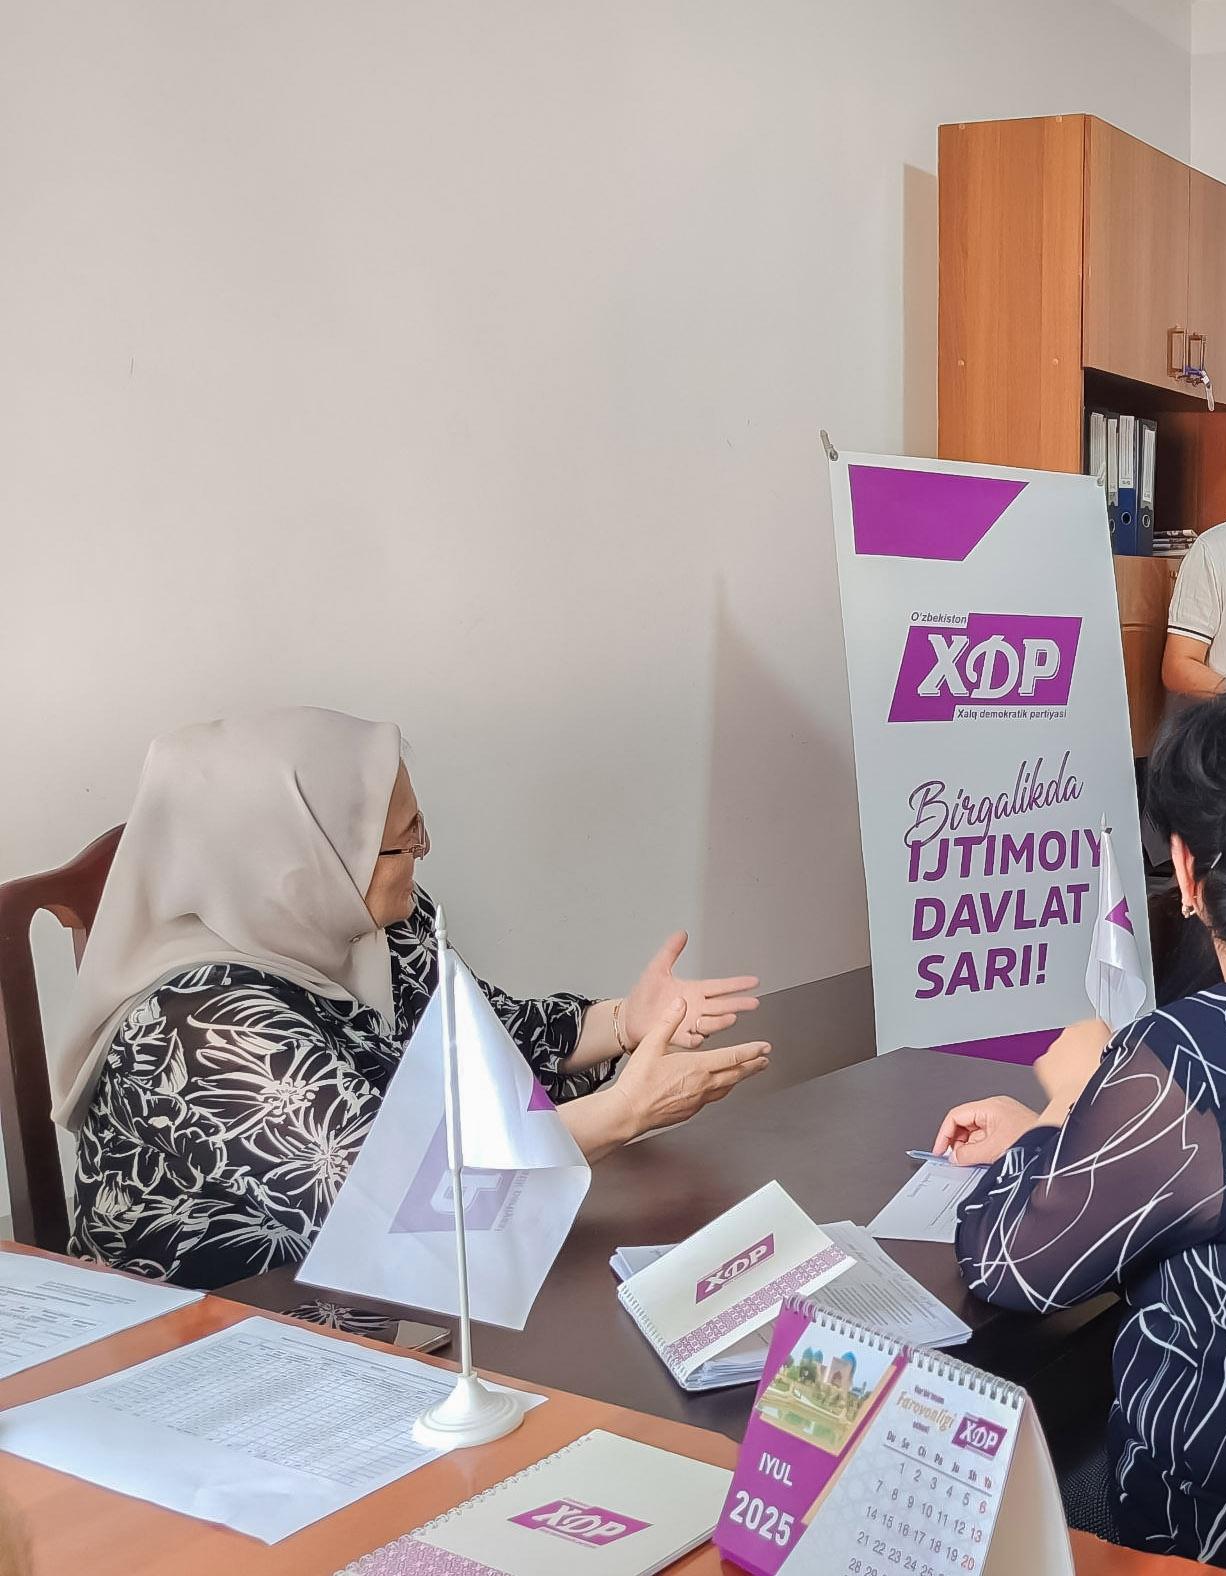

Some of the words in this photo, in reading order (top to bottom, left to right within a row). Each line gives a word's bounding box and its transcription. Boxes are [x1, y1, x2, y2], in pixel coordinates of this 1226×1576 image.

[911, 611, 967, 624] O'zbekiston
[917, 634, 1061, 699] XDP
[957, 709, 977, 721] Xalq
[980, 709, 1027, 719] demokratik
[1030, 709, 1067, 721] partiyasi
[903, 750, 1084, 849] Birgalikda
[908, 828, 1102, 882] IJTIMOIY
[912, 883, 1090, 941] DAVLAT
[914, 942, 1048, 999] SARI!
[704, 1245, 768, 1293] XDP
[960, 1420, 999, 1450] XDP
[758, 1452, 793, 1487] IYUL
[899, 1463, 905, 1475] 1
[913, 1469, 922, 1482] 2
[930, 1477, 938, 1490] 3
[946, 1485, 953, 1498] 4
[962, 1492, 971, 1505] 5
[979, 1500, 987, 1513] 6
[531, 1504, 627, 1538] XDP
[729, 1490, 795, 1546] 2025
[875, 1479, 883, 1493] 7
[891, 1488, 899, 1500] 8
[907, 1495, 915, 1508] 9
[921, 1502, 933, 1518] 10
[937, 1511, 948, 1527] 11
[954, 1519, 966, 1534] 12
[970, 1526, 982, 1543] 13
[857, 1531, 870, 1545] 21
[872, 1540, 886, 1555] 22
[888, 1548, 901, 1563] 23
[903, 1556, 917, 1572] 24
[920, 1564, 934, 1576] 25
[866, 1506, 878, 1520] 14
[882, 1513, 894, 1529] 15
[898, 1522, 910, 1536] 16
[913, 1529, 926, 1544] 17
[929, 1538, 941, 1553] 18
[946, 1546, 958, 1561] 19
[961, 1554, 975, 1570] 20
[848, 1557, 861, 1573] 28
